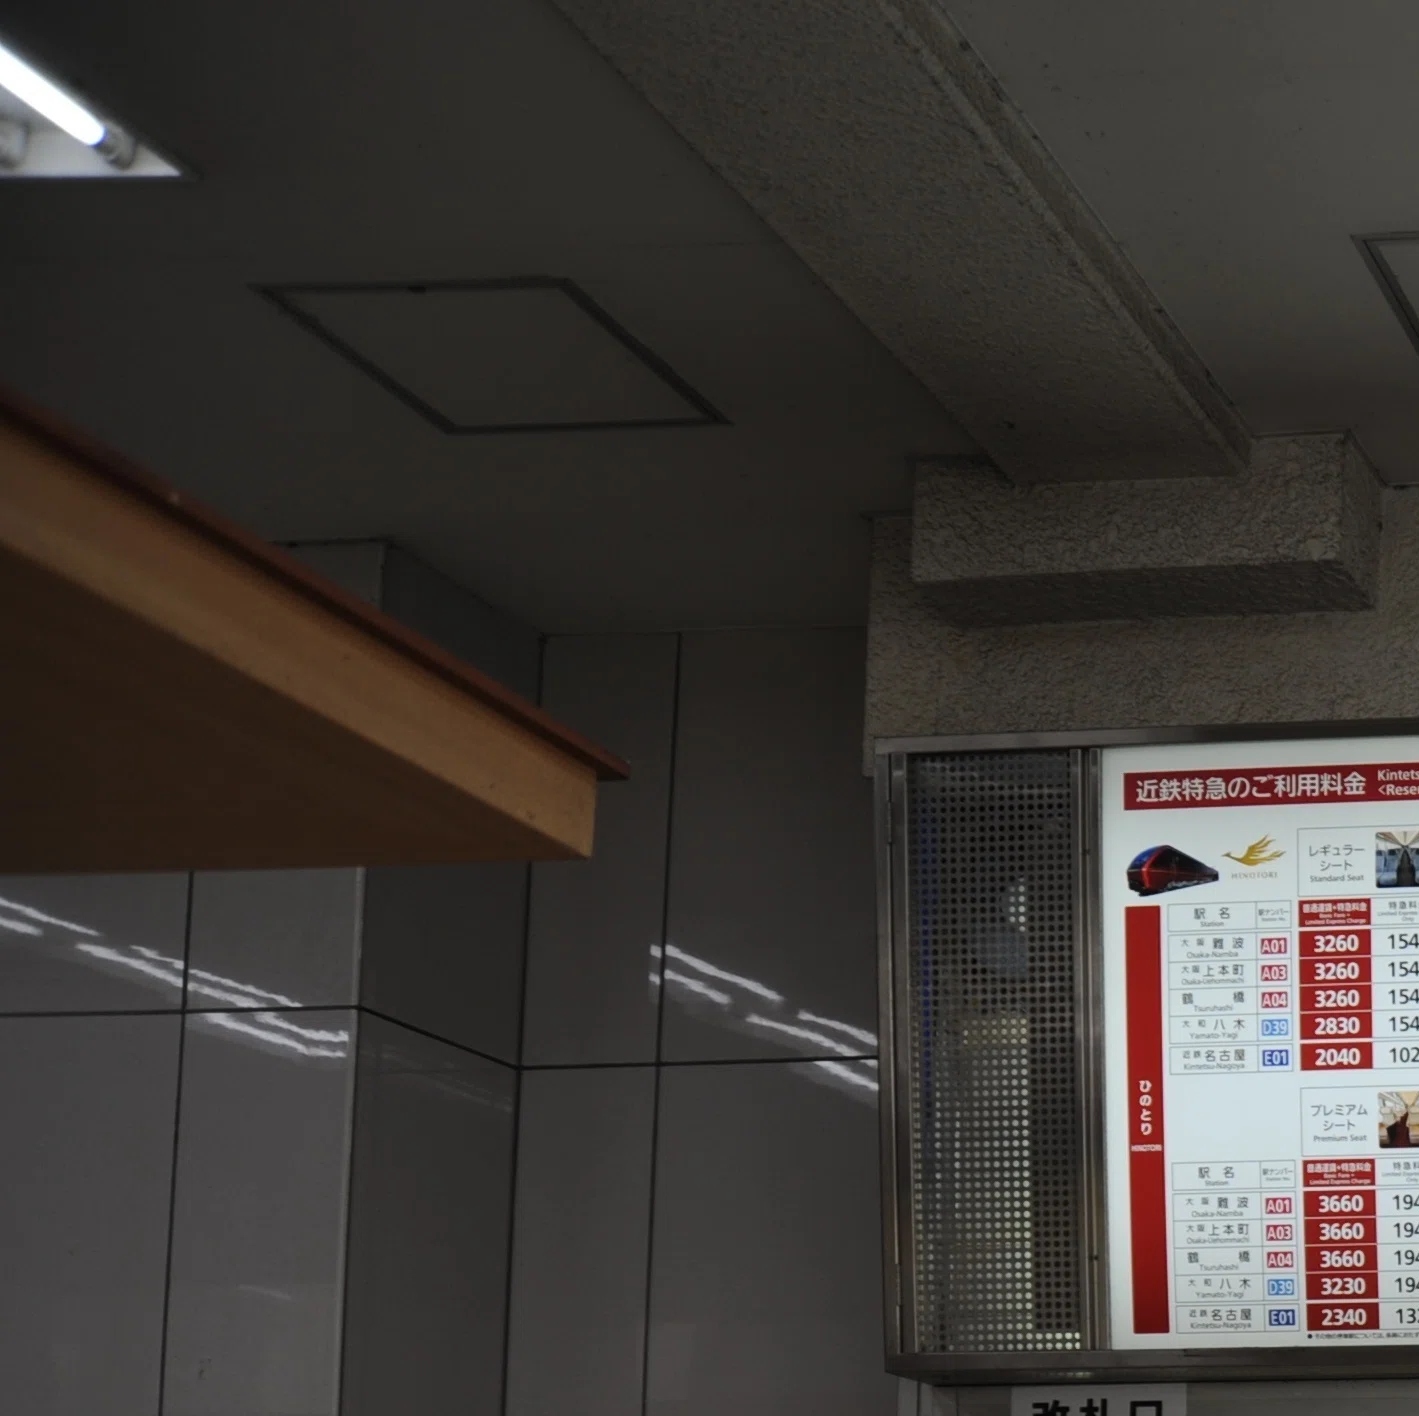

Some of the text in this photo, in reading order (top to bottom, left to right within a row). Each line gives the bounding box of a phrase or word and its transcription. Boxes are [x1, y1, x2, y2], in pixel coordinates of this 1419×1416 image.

[1135, 773, 1367, 803] 近鉄特急のご利用料金
[1308, 844, 1365, 857] レギュラー
[1314, 934, 1359, 953] 3260
[1314, 1016, 1360, 1035] 2830
[1315, 1048, 1360, 1067] 2040
[1310, 1104, 1368, 1118] プレミアム
[1321, 1307, 1366, 1326] 2340
